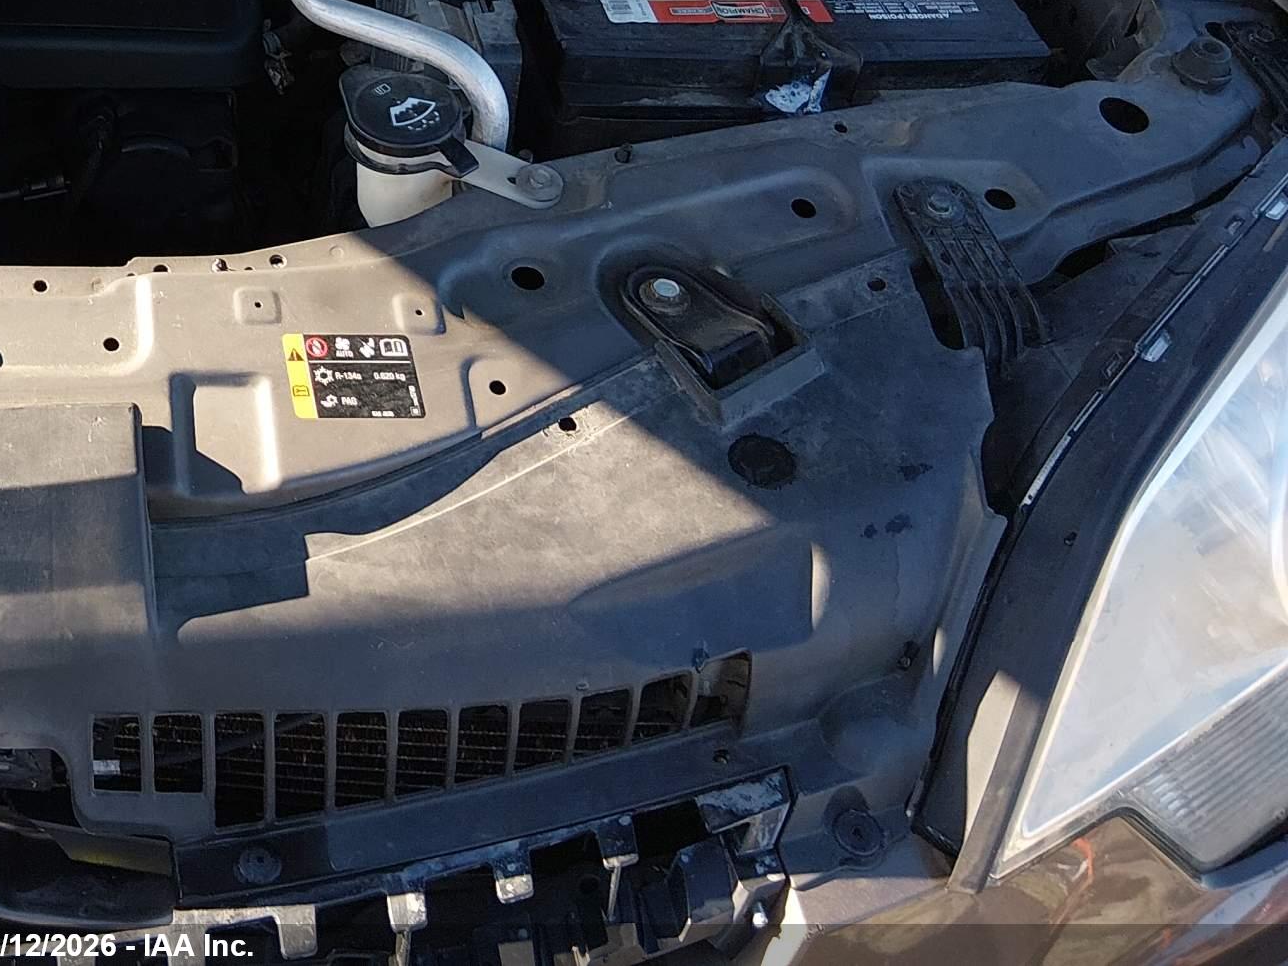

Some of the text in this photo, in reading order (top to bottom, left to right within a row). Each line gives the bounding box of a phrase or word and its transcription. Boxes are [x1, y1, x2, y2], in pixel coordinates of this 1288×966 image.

[716, 3, 766, 17] CHAMPION
[335, 350, 354, 358] AUTO
[335, 372, 362, 380] R-134a
[341, 396, 358, 406] PAG
